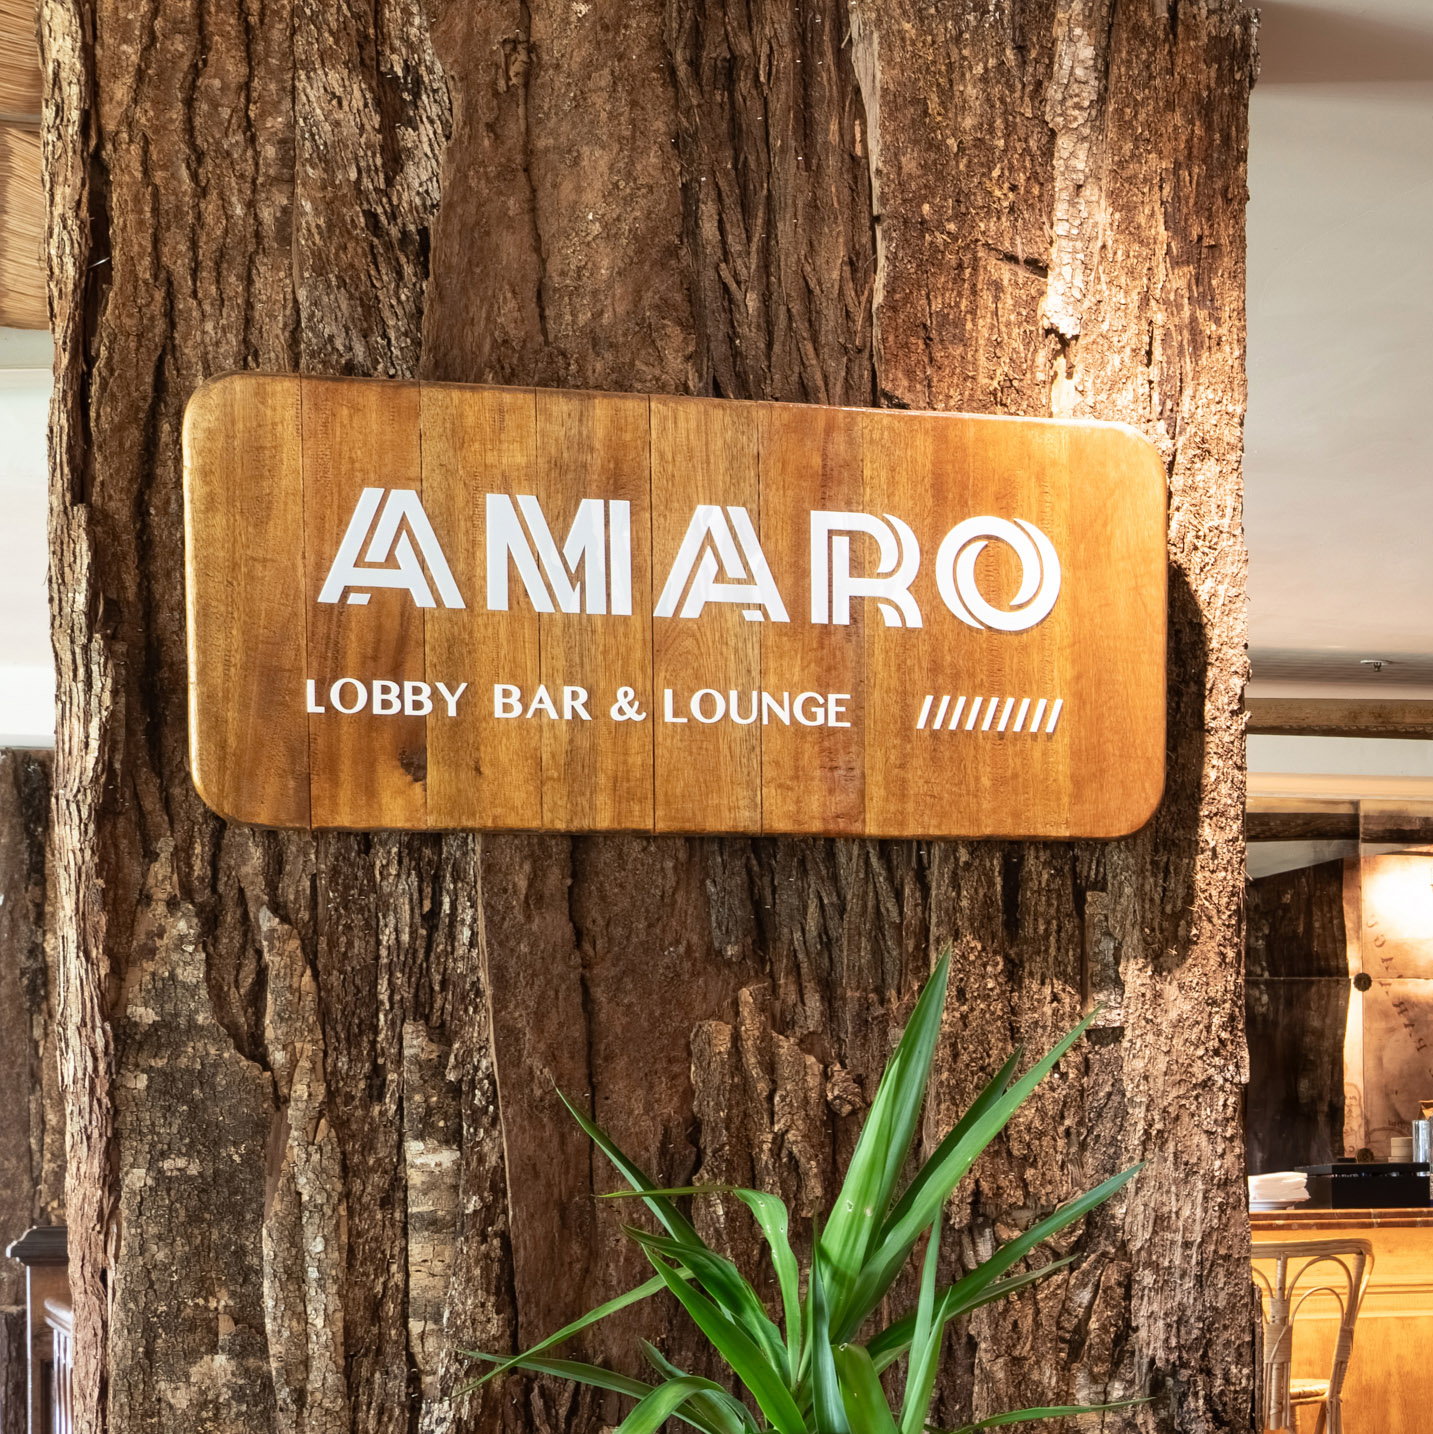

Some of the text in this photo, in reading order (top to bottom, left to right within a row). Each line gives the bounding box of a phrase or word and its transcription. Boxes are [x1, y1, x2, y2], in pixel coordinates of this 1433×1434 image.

[318, 487, 1063, 632] AMARO
[306, 678, 852, 728] LOBBY BAR & LOUNGE
